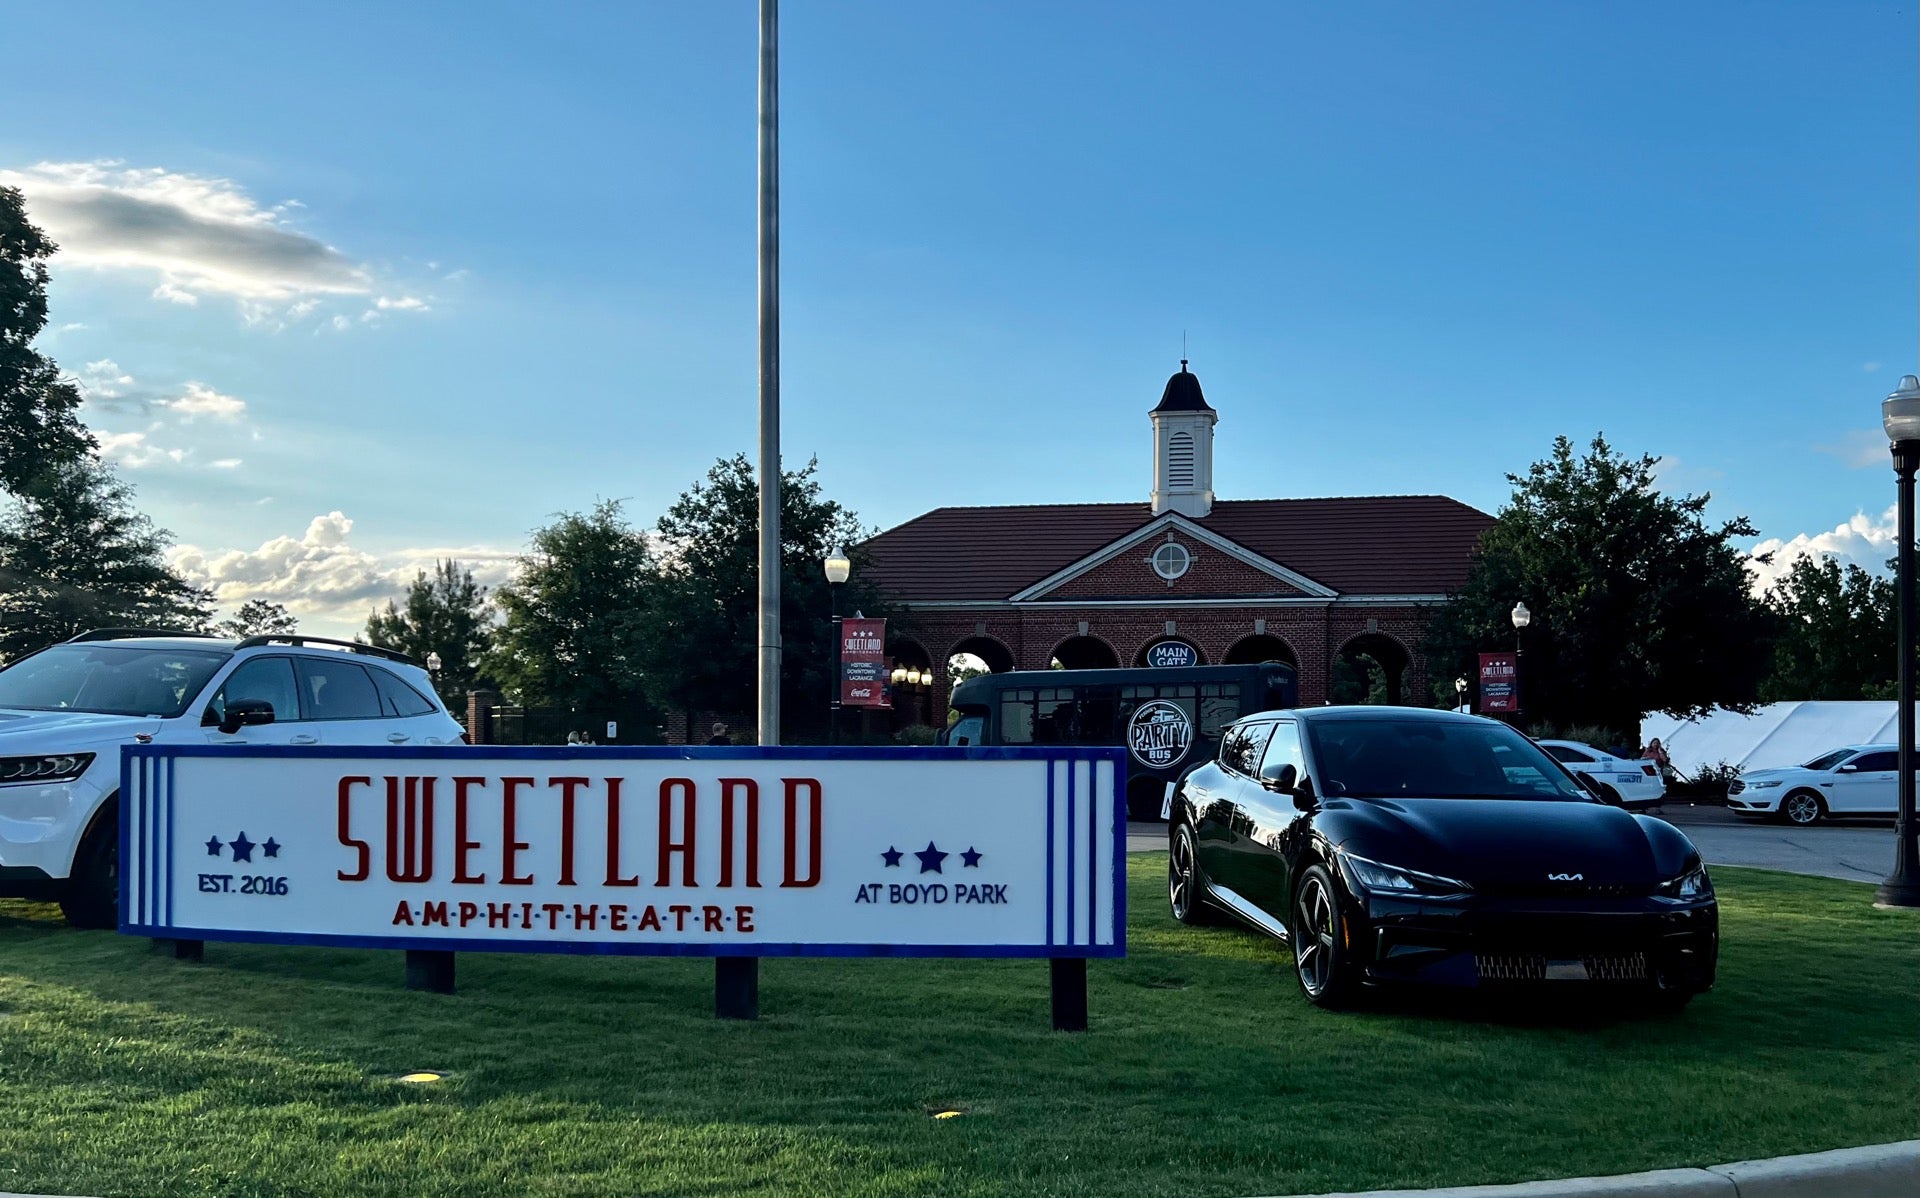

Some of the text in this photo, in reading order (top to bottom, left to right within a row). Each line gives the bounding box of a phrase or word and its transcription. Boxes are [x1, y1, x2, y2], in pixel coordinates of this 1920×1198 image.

[844, 638, 881, 650] SWEETLAND
[1156, 647, 1188, 657] MAIN
[1157, 657, 1187, 666] GATE
[1133, 722, 1186, 750] PARTY
[1148, 749, 1172, 759] BUS
[337, 775, 823, 888] SWEETLAND
[198, 873, 289, 896] EST. 2016
[855, 884, 1008, 905] AT BOYD PARK
